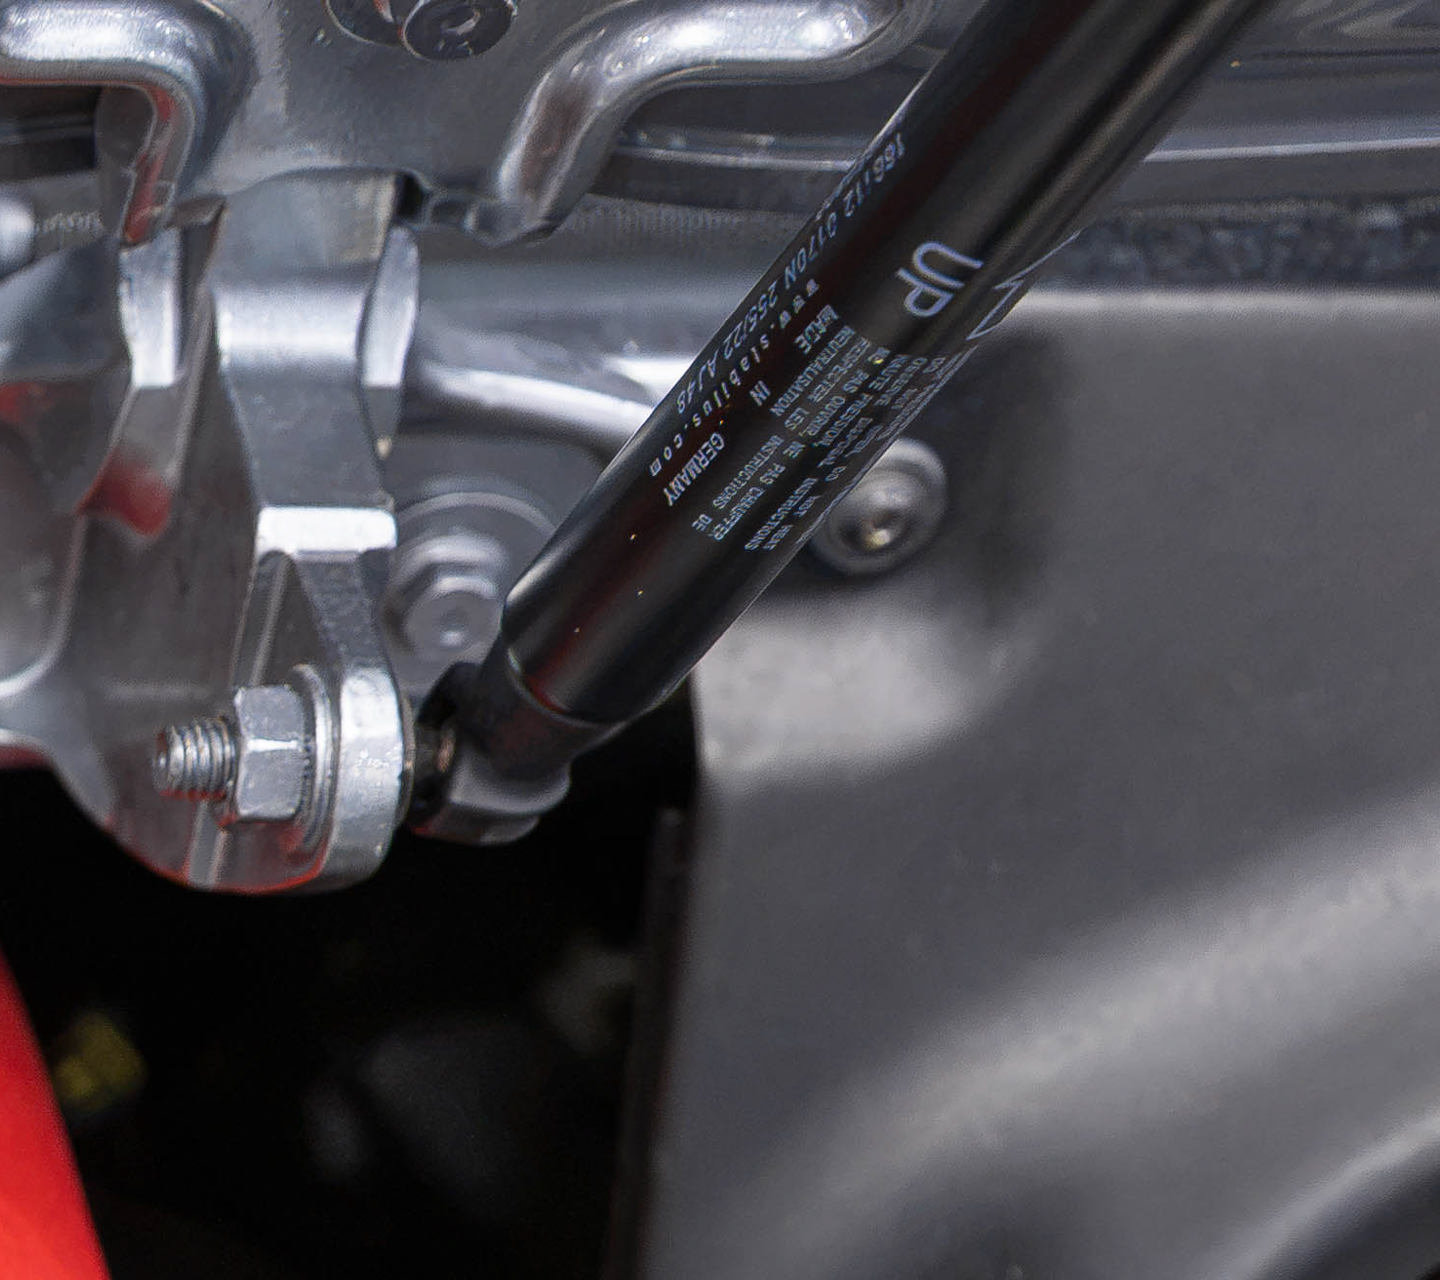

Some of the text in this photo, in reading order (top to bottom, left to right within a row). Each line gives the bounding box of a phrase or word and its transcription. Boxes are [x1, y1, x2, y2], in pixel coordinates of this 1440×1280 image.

[894, 240, 984, 319] UP
[663, 303, 838, 506] MADE IN GERMANY
[782, 405, 809, 431] LES
[710, 434, 783, 510] INSTRUCTIONS
[758, 462, 785, 485] PAS
[691, 513, 712, 531] DE
